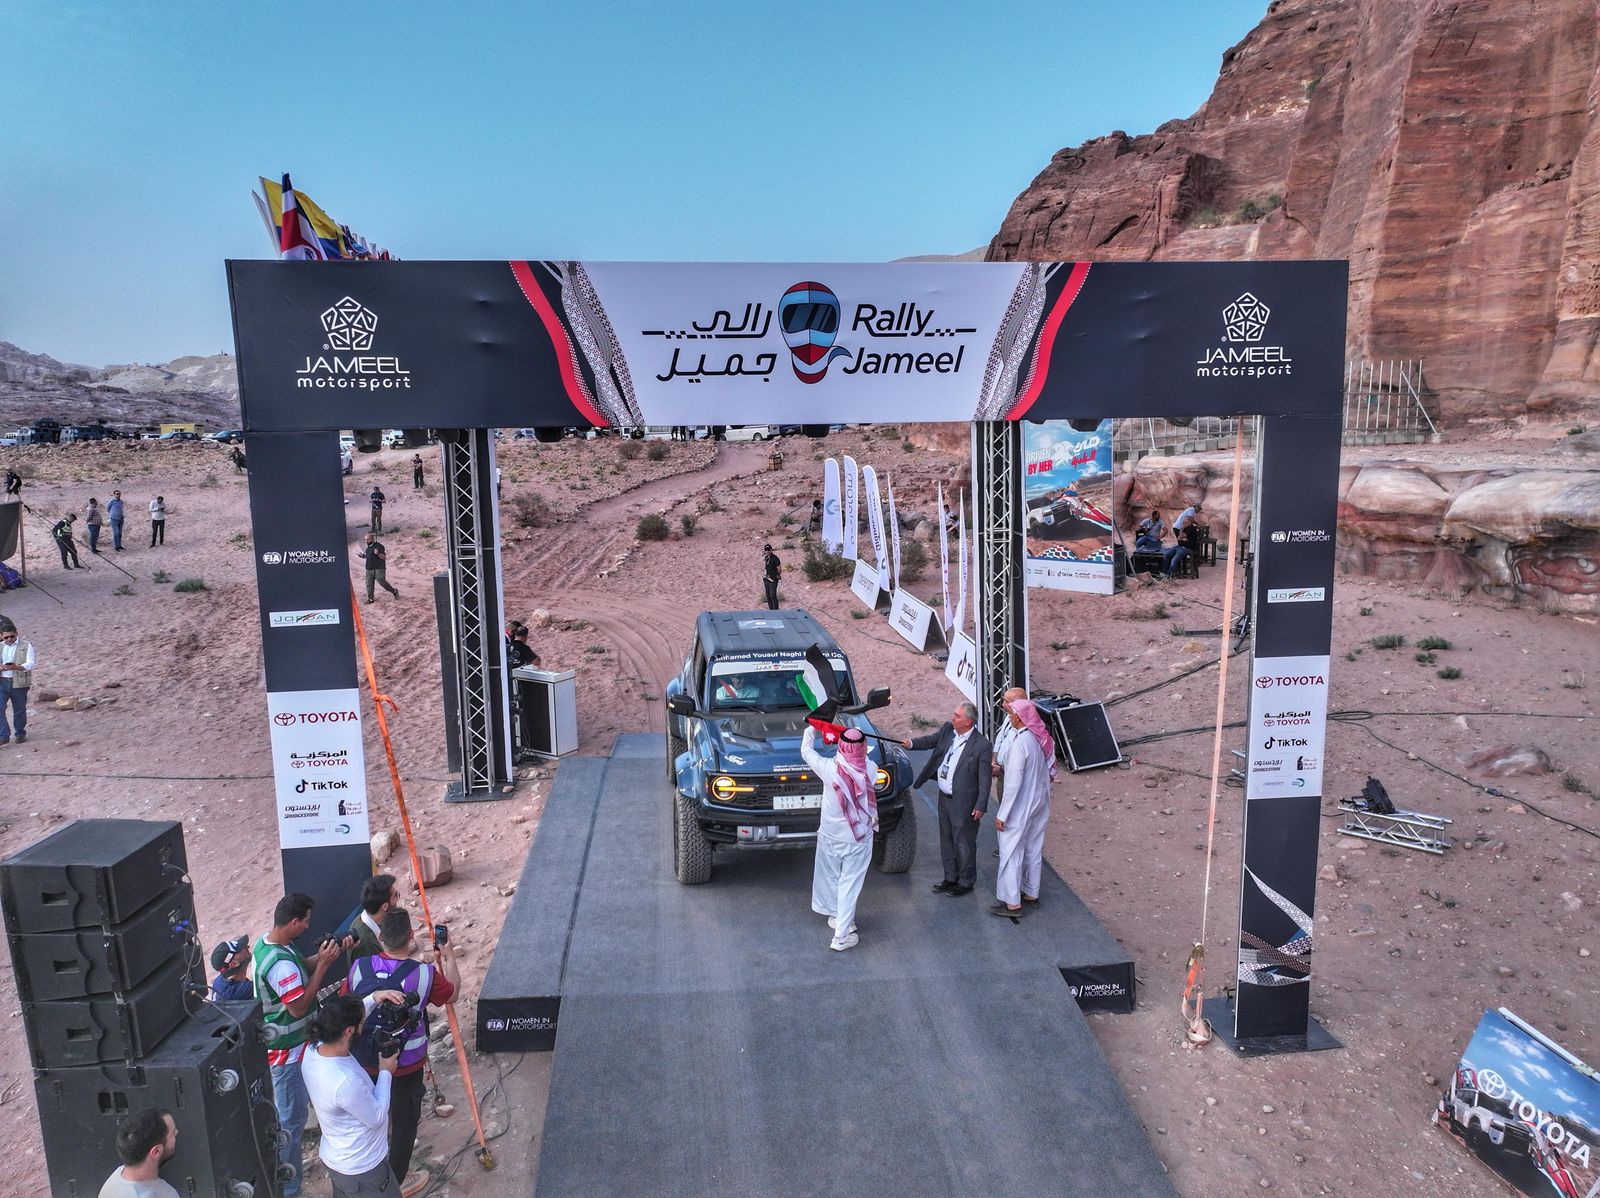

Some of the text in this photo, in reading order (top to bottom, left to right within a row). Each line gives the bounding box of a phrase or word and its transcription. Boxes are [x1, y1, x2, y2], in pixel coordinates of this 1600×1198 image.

[691, 303, 773, 339] رالي
[852, 303, 935, 337] Rally
[842, 345, 965, 375] Jameel
[1197, 347, 1292, 364] JAMEEL
[296, 356, 411, 374] JAMEEL
[656, 348, 777, 383] جميل
[1197, 364, 1292, 378] motorsport
[297, 376, 411, 392] motorsport
[1028, 460, 1053, 475] BY HER
[1271, 532, 1286, 541] FIA
[263, 553, 281, 563] FIA
[289, 556, 336, 564] MOTORSPORT
[1276, 676, 1324, 686] TOYOTA
[299, 711, 358, 724] TOYOTA
[1264, 711, 1311, 719] المركزية
[1277, 739, 1308, 747] TikTok
[290, 750, 347, 759] المركزية
[307, 759, 348, 767] TOYOTA
[311, 781, 348, 791] TikTok
[1084, 989, 1126, 997] MOTORSPORT
[487, 1020, 504, 1030] FIA
[511, 1022, 557, 1030] MOTORSPORT
[1508, 1089, 1590, 1169] TOYOTA
